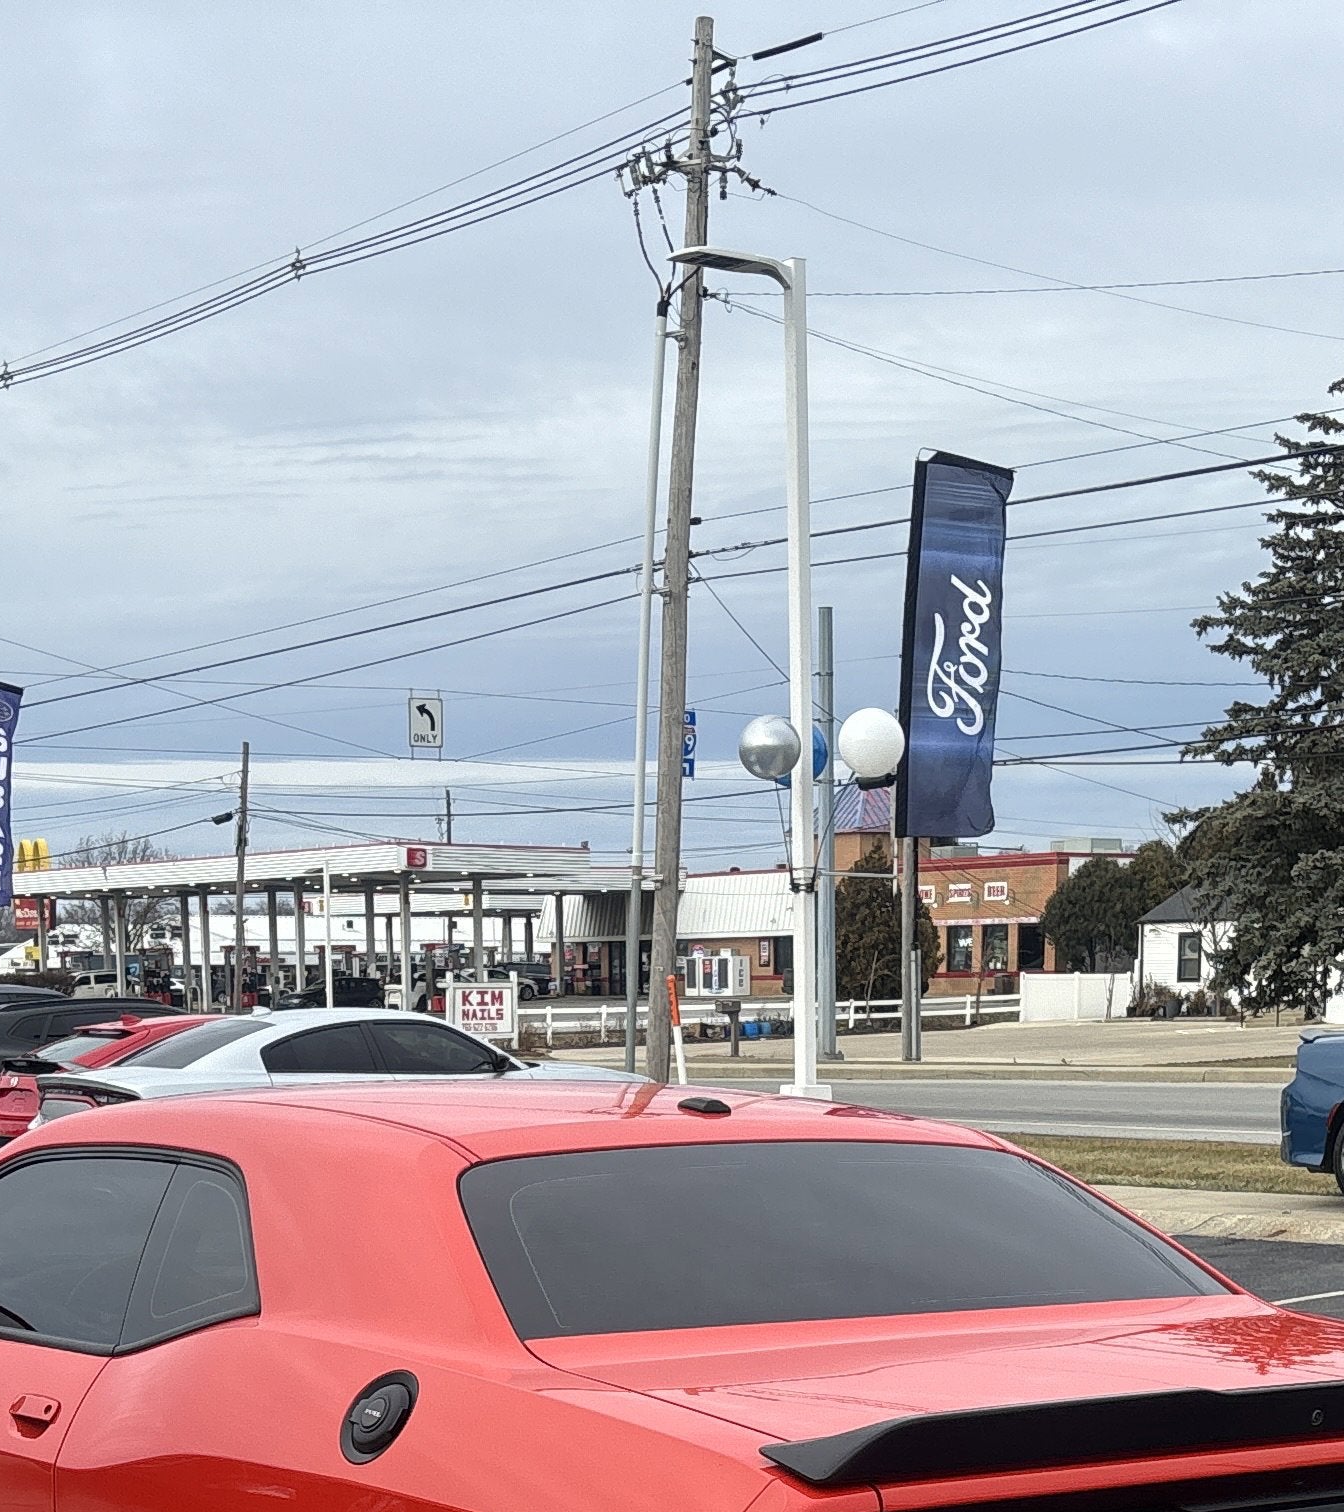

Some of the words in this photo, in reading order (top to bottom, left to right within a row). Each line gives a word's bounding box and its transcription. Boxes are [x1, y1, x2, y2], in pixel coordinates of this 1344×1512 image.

[927, 574, 992, 735] Ford
[413, 733, 438, 744] ONLY
[684, 735, 694, 751] 9
[987, 885, 1006, 898] BEER
[461, 990, 504, 1007] KIM
[461, 1008, 504, 1021] NAILS
[363, 1408, 382, 1418] FUEL
